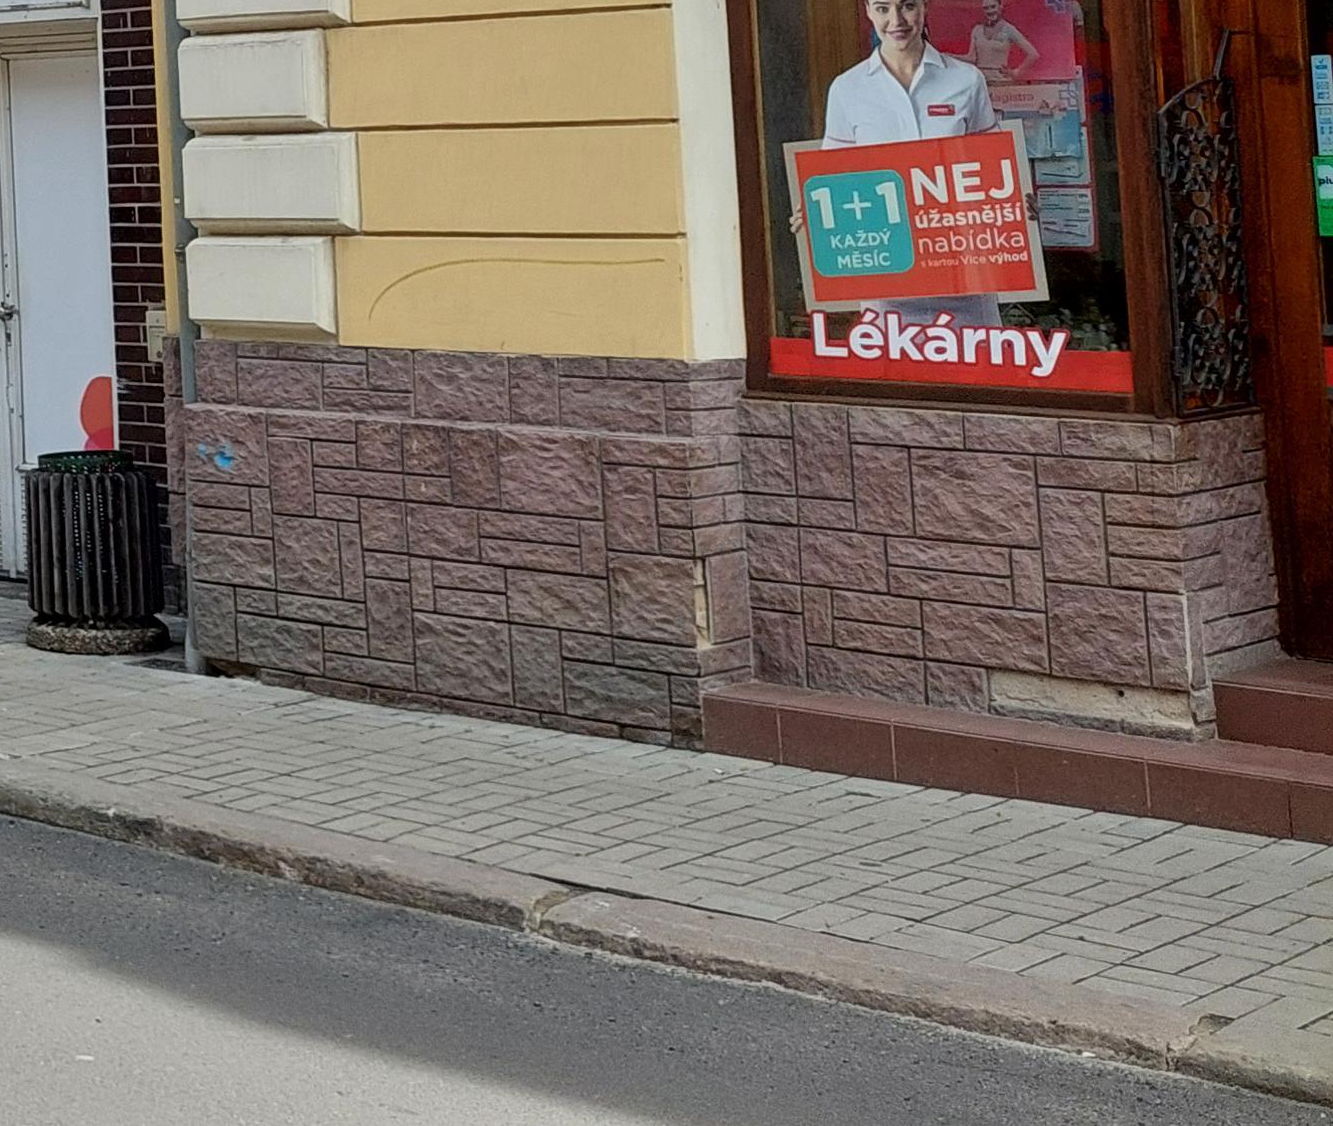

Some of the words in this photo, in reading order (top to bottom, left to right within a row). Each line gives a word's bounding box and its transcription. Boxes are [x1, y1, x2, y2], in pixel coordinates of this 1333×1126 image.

[910, 159, 1016, 206] NEJ
[810, 181, 901, 230] 1+1
[915, 203, 1022, 230] úžasnější
[830, 228, 892, 250] KAŽDÝ
[918, 228, 1025, 254] nabídka
[837, 250, 892, 270] MĚSÍC
[988, 250, 1028, 265] výhod
[812, 311, 1067, 377] Lékárny
